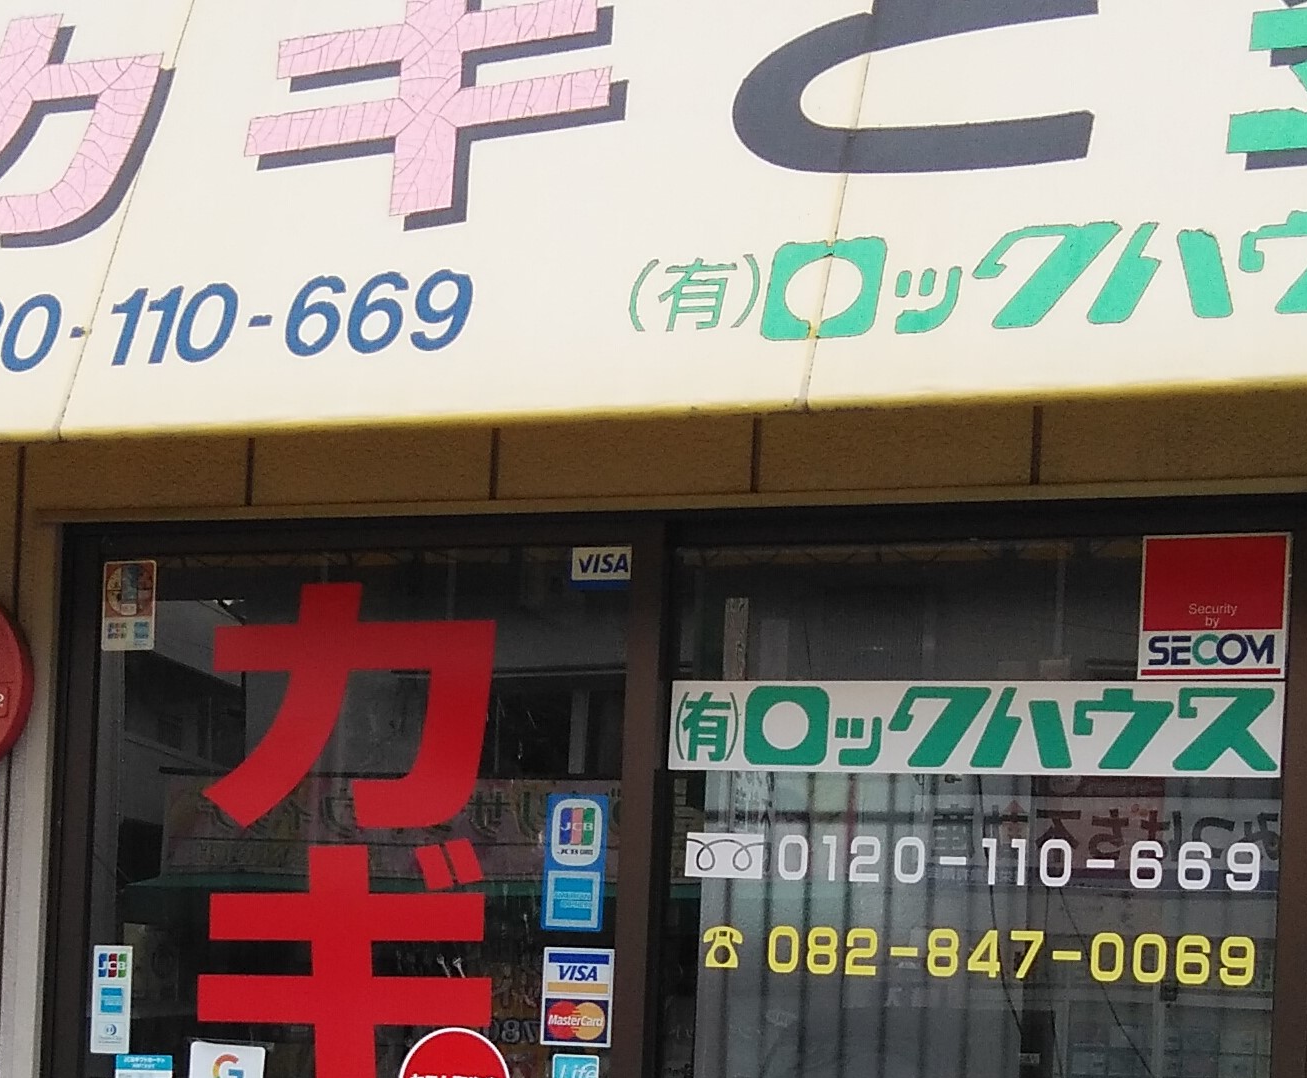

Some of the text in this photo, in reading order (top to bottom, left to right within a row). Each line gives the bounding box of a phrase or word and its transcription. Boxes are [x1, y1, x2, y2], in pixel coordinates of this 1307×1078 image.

[578, 553, 629, 573] VISA
[1188, 603, 1238, 616] Security
[1205, 616, 1220, 628] by
[1148, 633, 1275, 665] SECOM
[675, 684, 1279, 772] (有)ロックハウス
[777, 834, 1261, 891] 0120-110-669
[768, 924, 1256, 986] 082-847-0069
[558, 965, 598, 981] VISA
[548, 1015, 604, 1027] MasterCard
